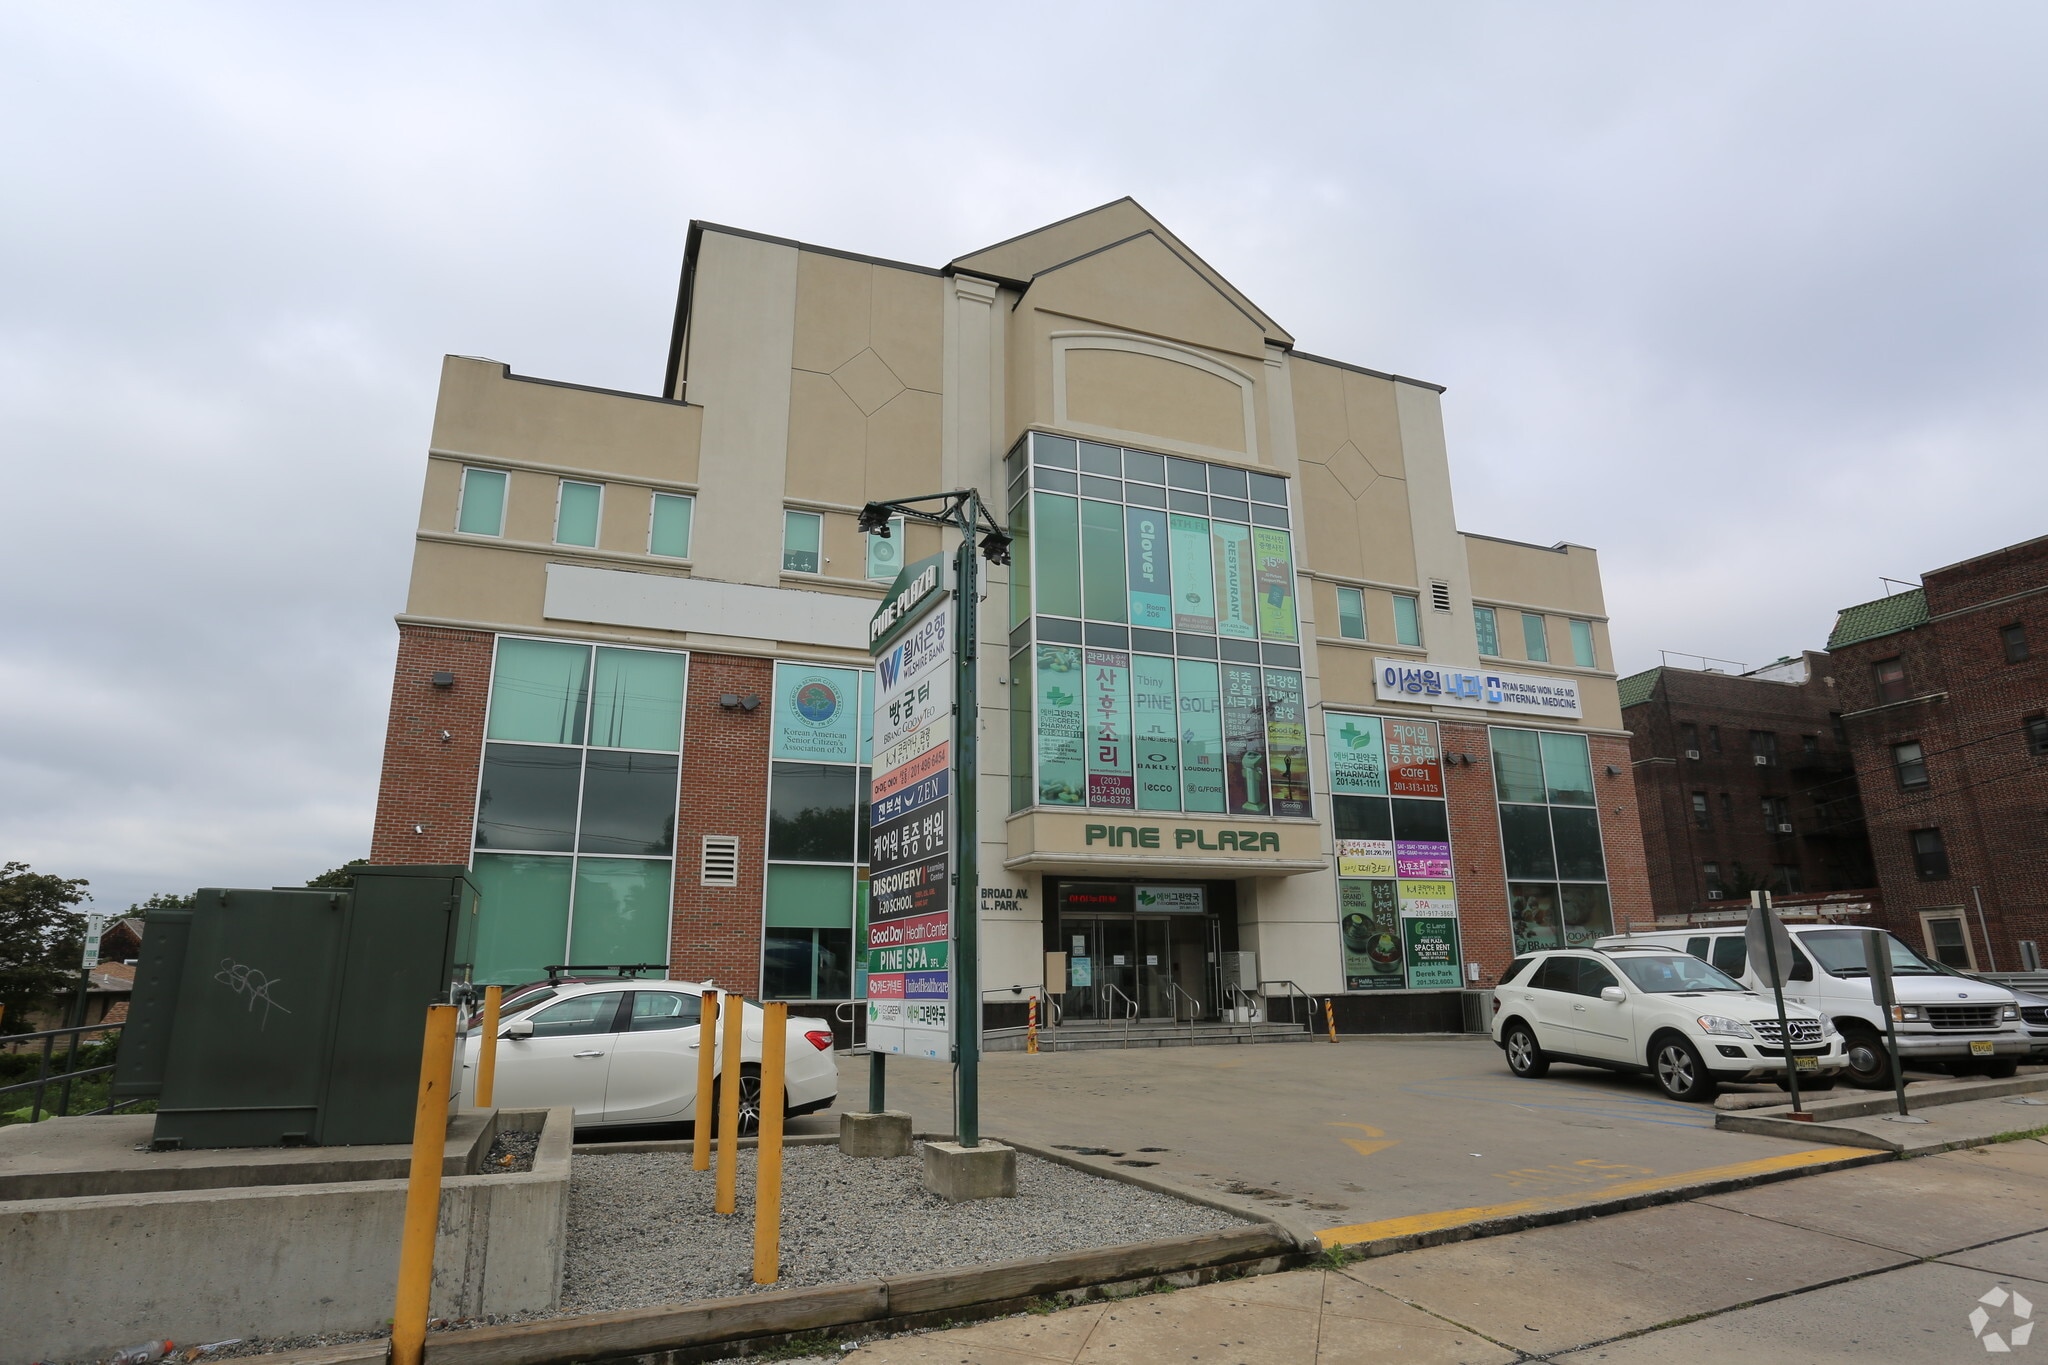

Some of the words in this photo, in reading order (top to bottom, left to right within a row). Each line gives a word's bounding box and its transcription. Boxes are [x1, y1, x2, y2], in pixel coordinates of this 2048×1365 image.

[1140, 520, 1155, 582] Clover
[1228, 540, 1240, 620] RESTAURANT
[872, 601, 896, 642] PINE
[897, 565, 936, 618] PLAZA
[1146, 610, 1160, 618] 206
[904, 654, 928, 678] WILSHIRE
[929, 642, 945, 664] BANK
[1088, 651, 1114, 664] 관리사
[1229, 671, 1252, 684] 척추
[1266, 674, 1298, 688] 건강한
[1384, 668, 1442, 695] 이성원
[1445, 674, 1483, 700] 내과
[1230, 683, 1252, 696] 온열
[1502, 682, 1518, 691] RYAN
[1520, 684, 1536, 693] SUNG
[1537, 686, 1552, 695] WON
[1554, 688, 1564, 696] LEE
[1565, 688, 1574, 697] MD
[1137, 694, 1172, 710] PINE
[1180, 698, 1220, 714] GOLF
[1504, 692, 1540, 705] INTERNAL
[1542, 696, 1576, 708] MEDICINE
[1041, 708, 1080, 718] 에버그린약국
[1041, 716, 1080, 724] EVERGREEN
[1096, 668, 1118, 766] 산후조리
[1274, 706, 1294, 720] 완성
[784, 728, 810, 736] Korean
[812, 730, 846, 739] American
[1041, 730, 1080, 738] 201-941-1111
[1269, 726, 1288, 734] Good
[1393, 724, 1430, 746] 케어원
[782, 744, 825, 752] Association
[786, 736, 810, 744] Senior
[812, 738, 844, 746] Citizen's
[1334, 752, 1378, 764] 에버그린약국
[1389, 744, 1437, 766] 통증병원
[1334, 762, 1379, 772] EVERGREEN
[1400, 766, 1430, 782] care1
[1100, 776, 1120, 786] (201)
[1336, 770, 1380, 779] PHARMACY
[1336, 778, 1380, 788] 201-941-1111
[1394, 782, 1438, 792] 201-313-1125
[918, 778, 938, 804] ZEN
[1091, 786, 1130, 796] 317-3000
[1091, 794, 1130, 804] 494-8378
[874, 829, 898, 861] 케어원
[924, 810, 944, 850] 병원
[1086, 824, 1160, 848] PINE
[1176, 828, 1280, 852] PLAZA
[1398, 860, 1426, 876] 산후조리
[872, 867, 922, 896] DISCOVERY
[930, 872, 944, 882] Center
[981, 888, 1012, 898] BROAD
[1156, 892, 1200, 902] 에버그린약국
[890, 895, 913, 913] SCHOOL
[1414, 900, 1430, 909] SPA
[870, 926, 888, 944] Good
[890, 926, 904, 943] Day
[906, 924, 926, 940] Health
[926, 921, 948, 938] Center
[880, 950, 902, 970] PINE
[906, 947, 928, 970] SPA
[906, 978, 948, 994] UnitedHealthcare
[906, 1005, 946, 1026] 에버그린약국
